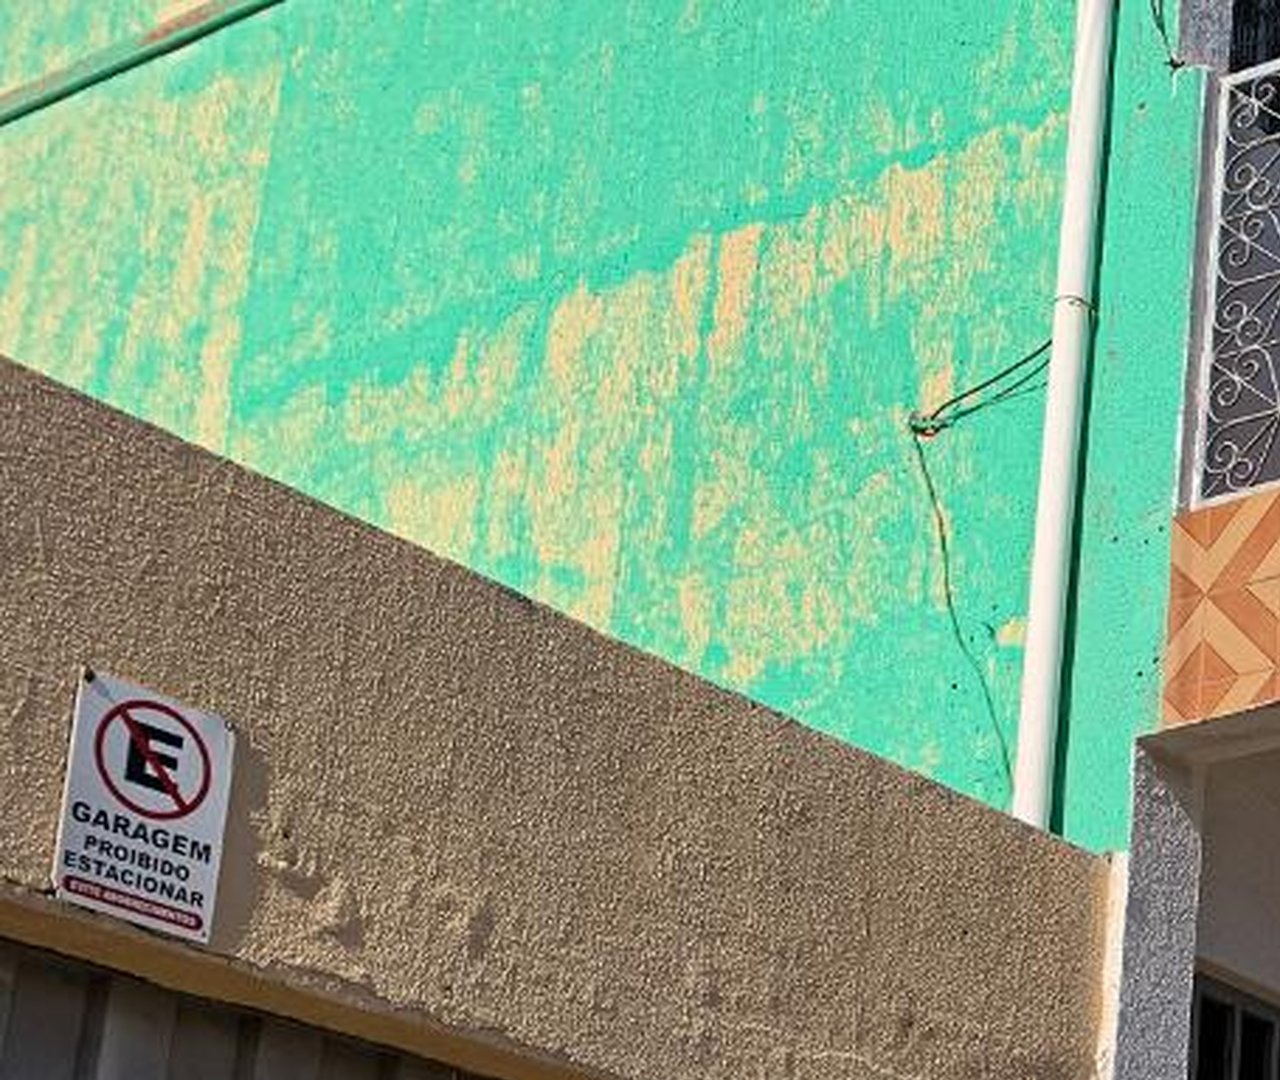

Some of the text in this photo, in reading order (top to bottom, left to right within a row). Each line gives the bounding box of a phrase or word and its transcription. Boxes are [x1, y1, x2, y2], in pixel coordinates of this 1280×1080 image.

[72, 801, 212, 865] GARAGEM
[84, 835, 190, 882] PROIBIDO
[63, 850, 204, 908] ESTACIONAR
